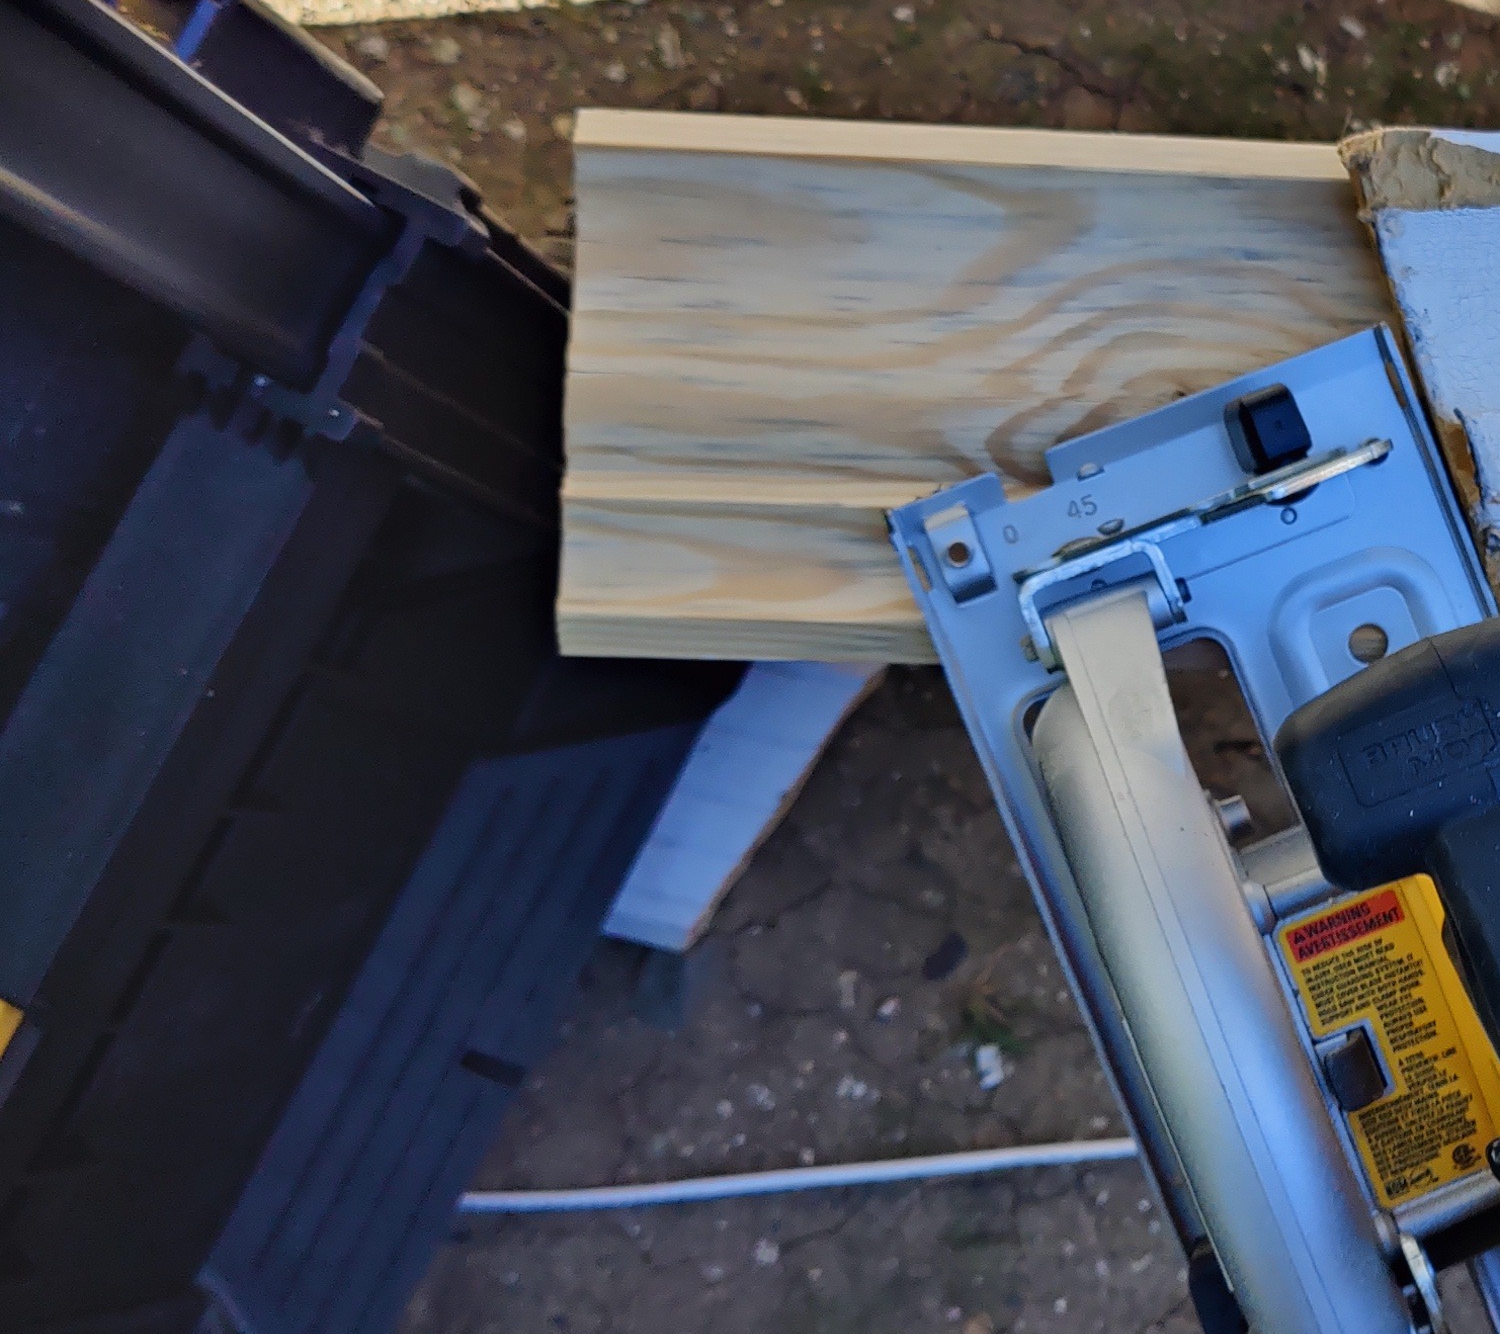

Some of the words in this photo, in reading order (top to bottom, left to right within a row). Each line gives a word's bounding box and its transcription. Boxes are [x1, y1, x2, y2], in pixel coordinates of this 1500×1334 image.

[1067, 494, 1098, 518] 45
[1297, 907, 1400, 960] AVERTISSEMENT
[1304, 901, 1370, 939] WARNING
